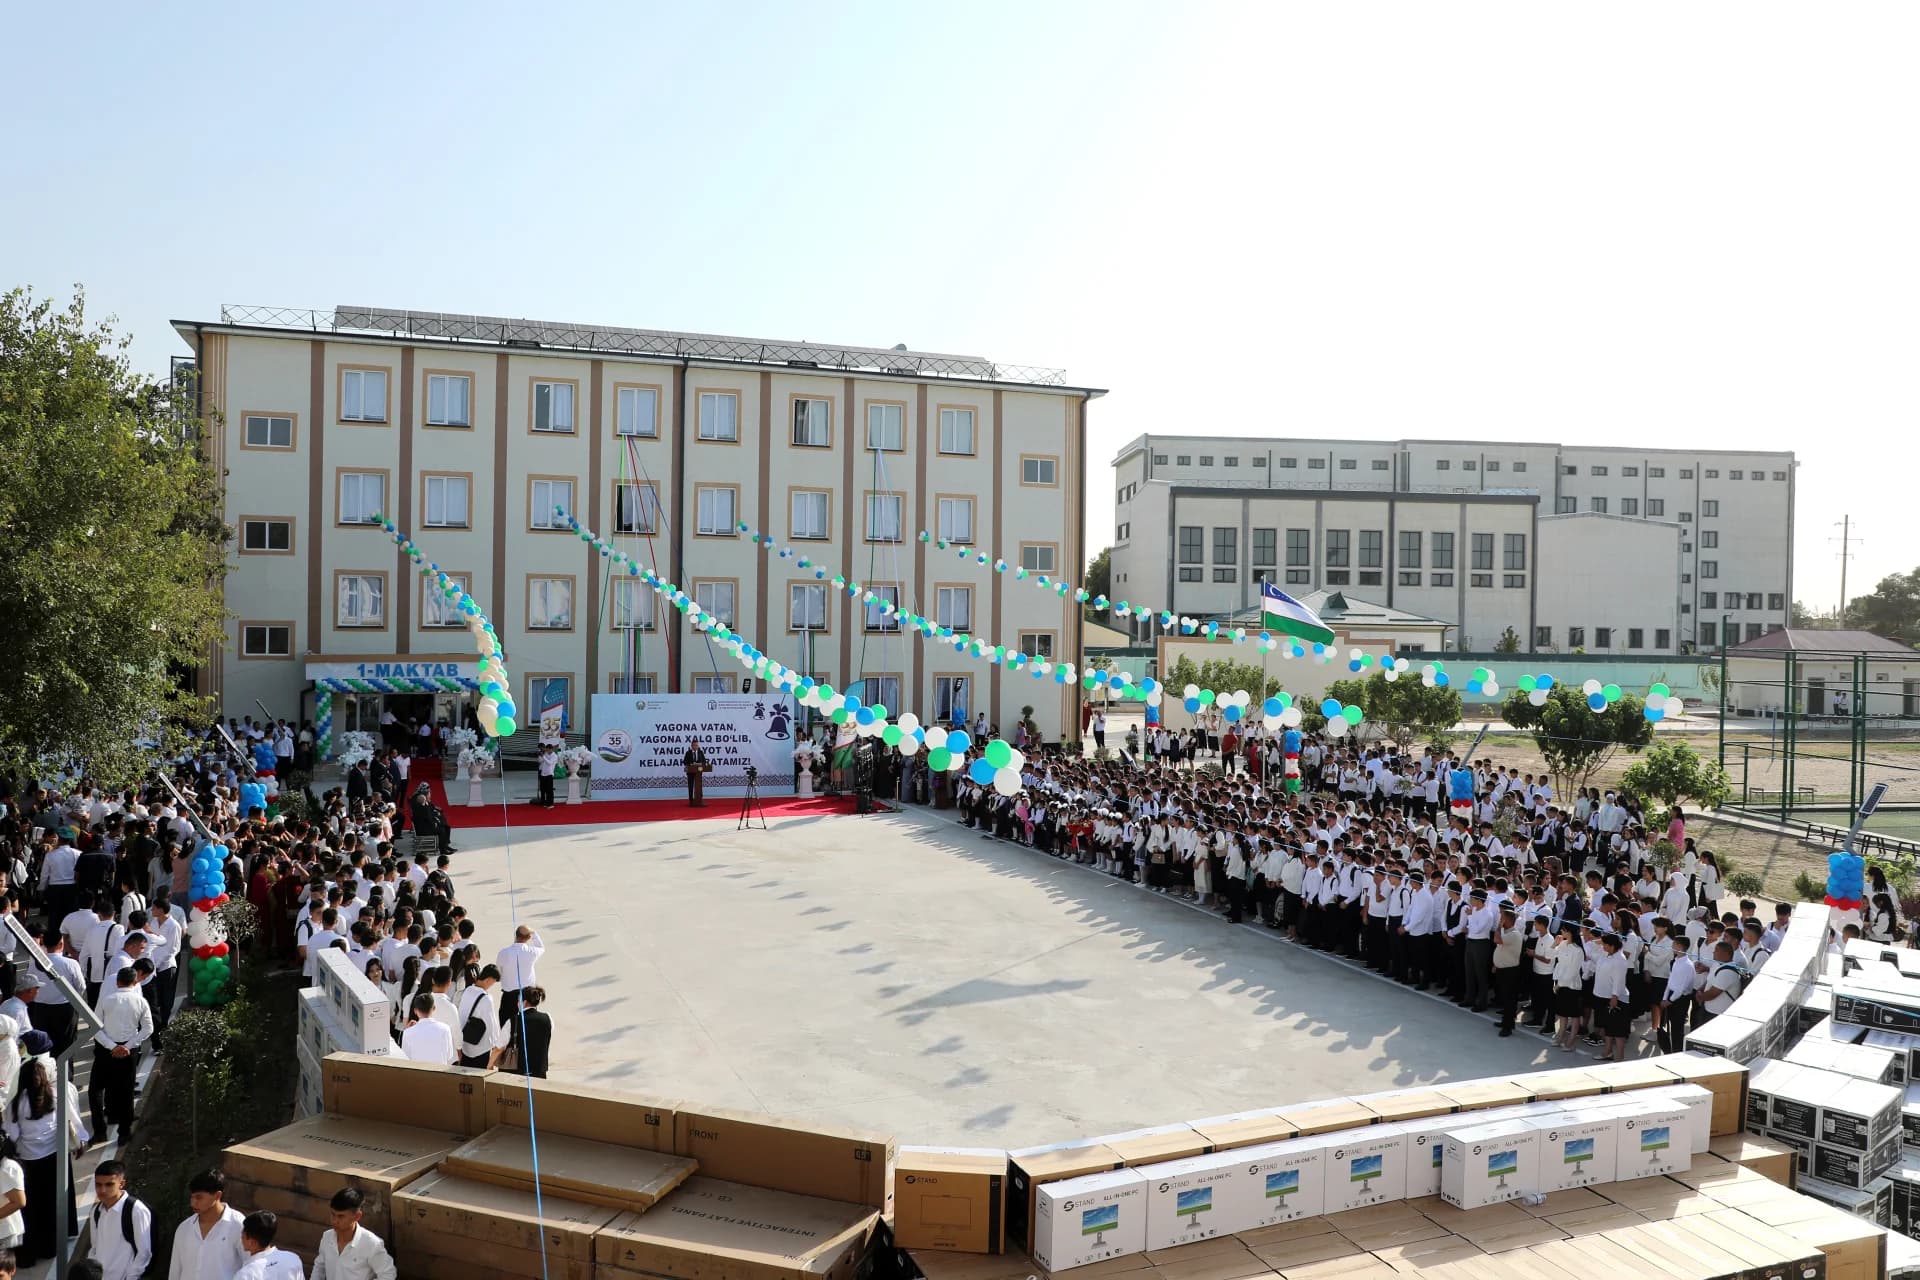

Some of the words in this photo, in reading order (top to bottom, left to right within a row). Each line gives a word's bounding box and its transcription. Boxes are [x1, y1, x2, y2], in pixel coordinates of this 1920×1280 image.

[357, 663, 459, 678] 1-MAKTAB
[655, 723, 697, 732] YAGONA
[701, 723, 736, 732] VATAN,
[609, 737, 621, 745] 35
[639, 735, 682, 744] YAGONA
[685, 735, 712, 744] XALQ
[653, 747, 684, 756] YANGI
[724, 746, 738, 755] VA
[690, 1129, 719, 1140] FRONT
[1285, 1157, 1310, 1166] ALL-IN-ONE
[1259, 1163, 1278, 1172] STAND
[916, 1176, 938, 1184] STAND
[1197, 1174, 1225, 1184] ALL-IN-ONE
[1170, 1180, 1190, 1190] STAND
[1104, 1191, 1131, 1201] ALL-IN-ONE
[1075, 1198, 1095, 1207] STAND
[671, 1206, 707, 1218] PANEL
[706, 1213, 736, 1224] FLAT
[736, 1219, 817, 1238] INTERACTIVE
